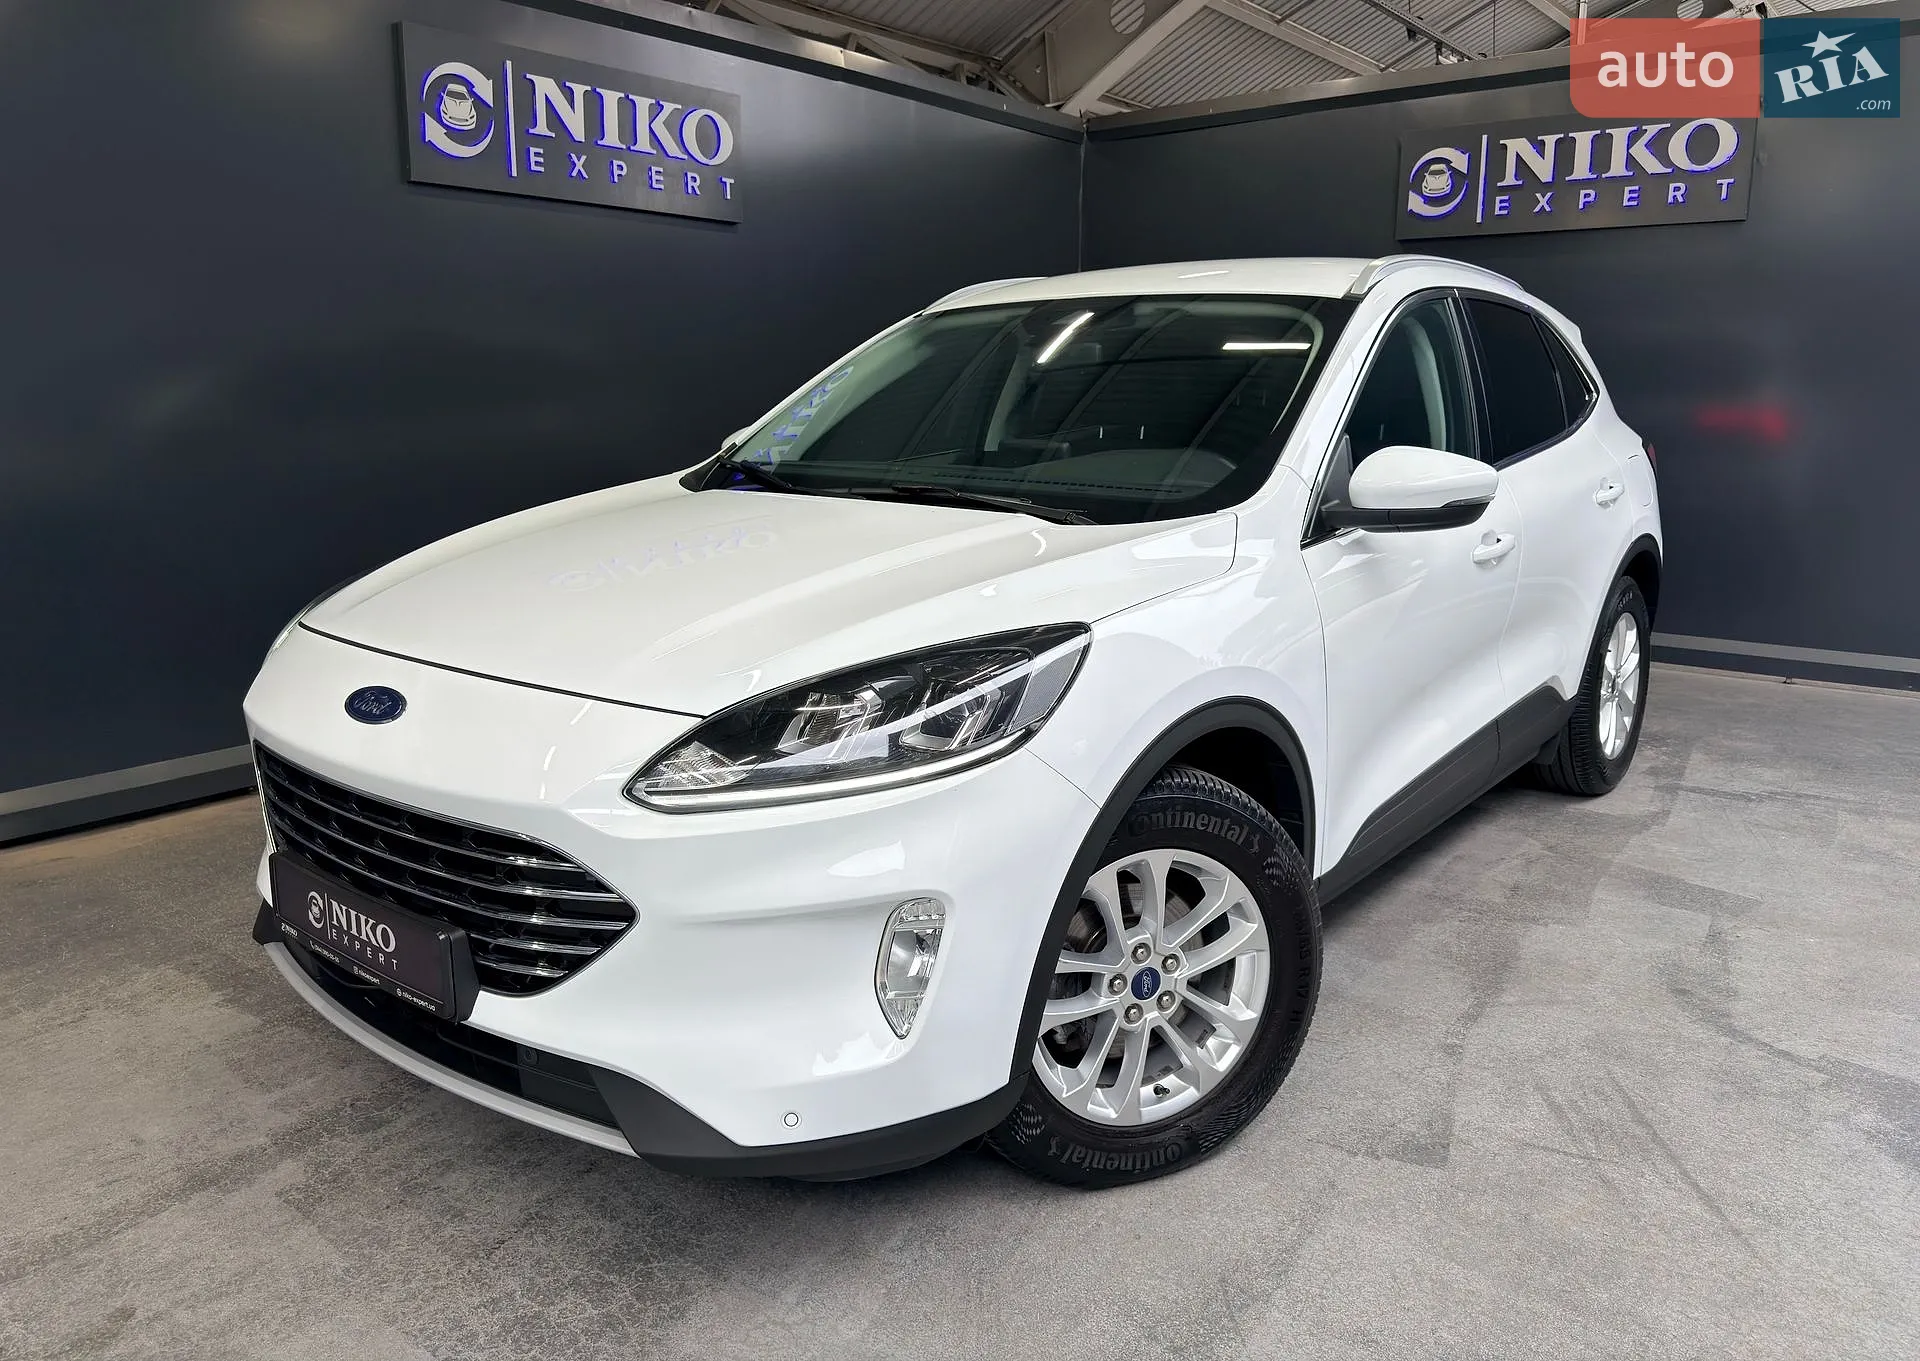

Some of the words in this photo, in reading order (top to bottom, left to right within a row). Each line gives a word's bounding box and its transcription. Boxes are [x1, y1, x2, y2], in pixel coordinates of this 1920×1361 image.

[525, 73, 735, 167] NIKO
[527, 147, 735, 200] EXPERT
[1496, 117, 1740, 187] NIKO
[1494, 178, 1735, 217] EXPERT
[353, 690, 393, 715] Ford
[1127, 805, 1250, 846] Continental
[329, 898, 396, 953] NIKO
[331, 928, 399, 971] EXPERT
